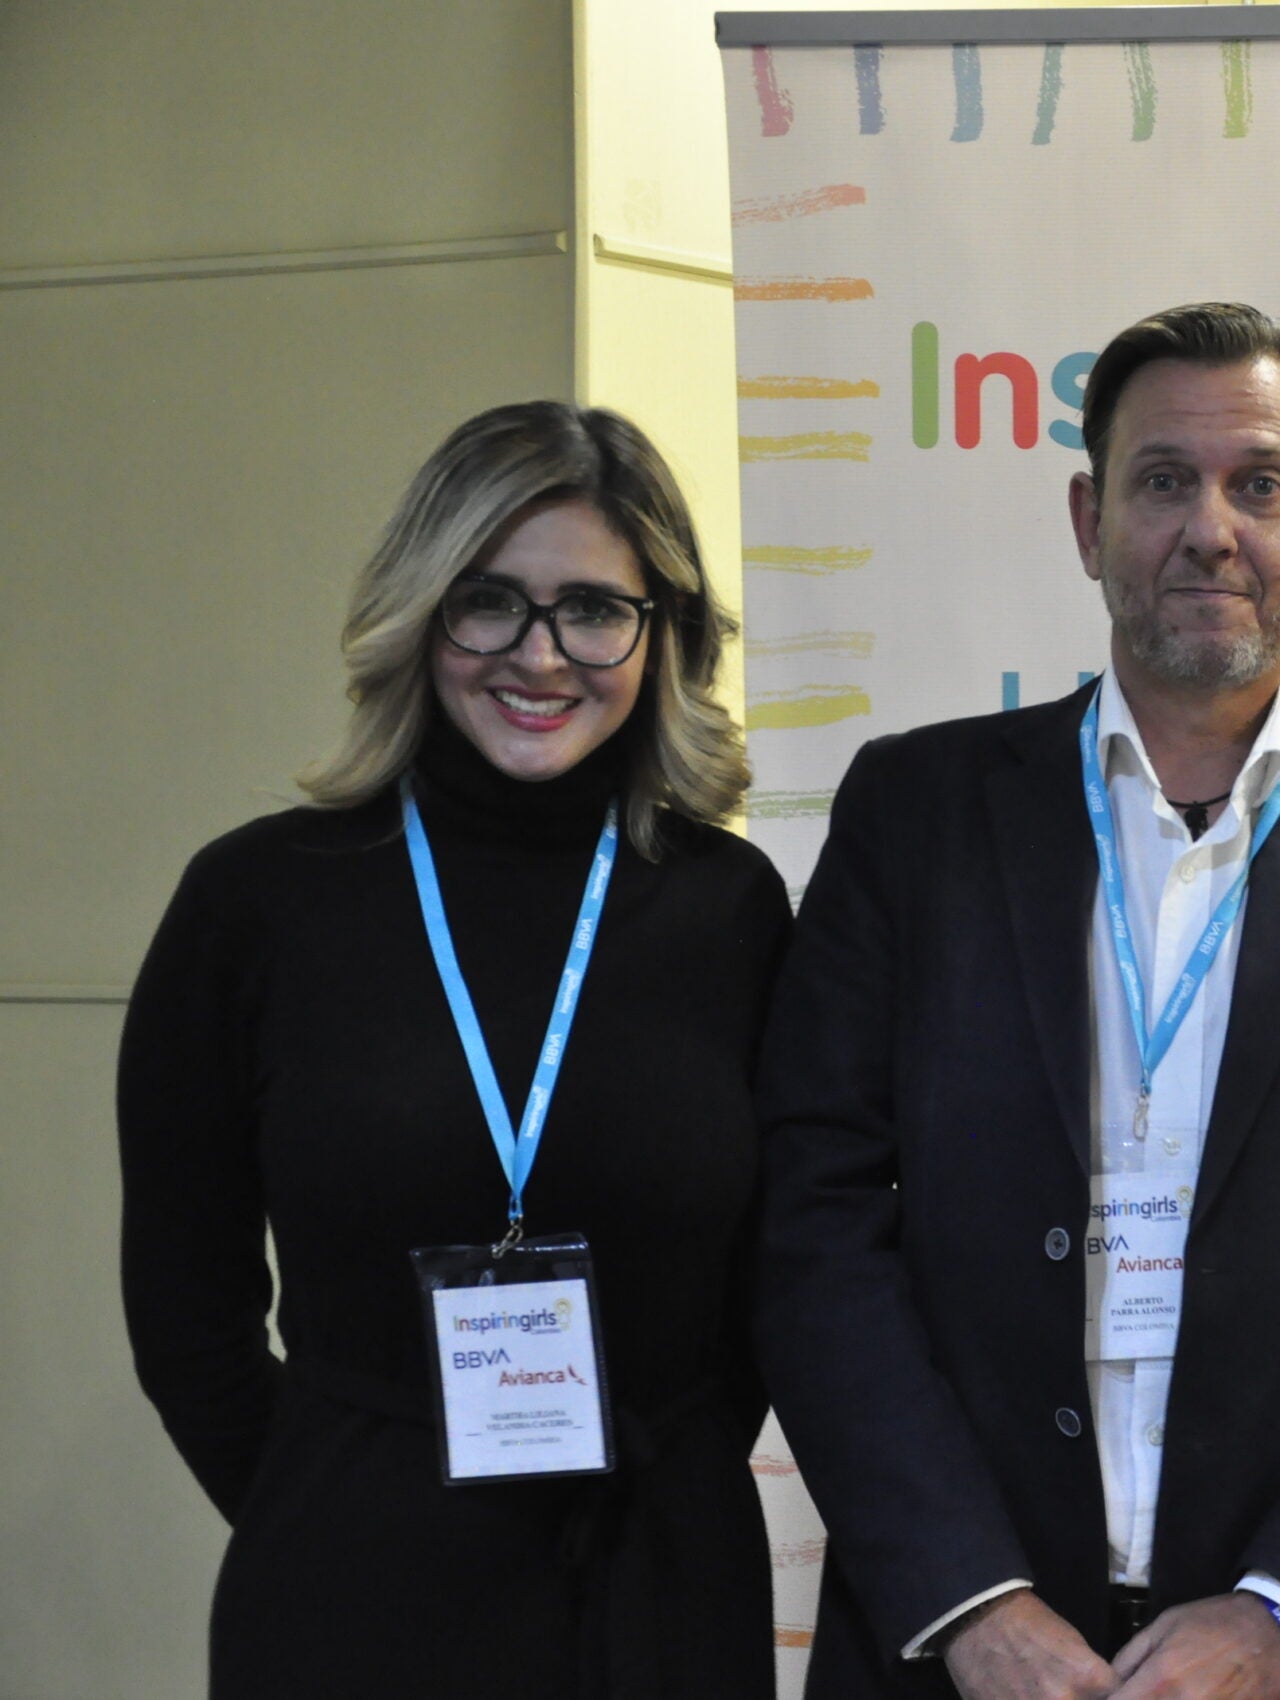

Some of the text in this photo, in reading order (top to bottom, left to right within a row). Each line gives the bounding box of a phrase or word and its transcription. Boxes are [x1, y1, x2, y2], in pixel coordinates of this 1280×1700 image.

[1091, 1196, 1178, 1222] spiringirls
[1087, 1235, 1130, 1255] BVA
[1116, 1256, 1184, 1274] Avianca
[453, 1308, 557, 1336] Inspiringirls
[453, 1348, 511, 1370] BBVA
[499, 1365, 565, 1388] Avianca
